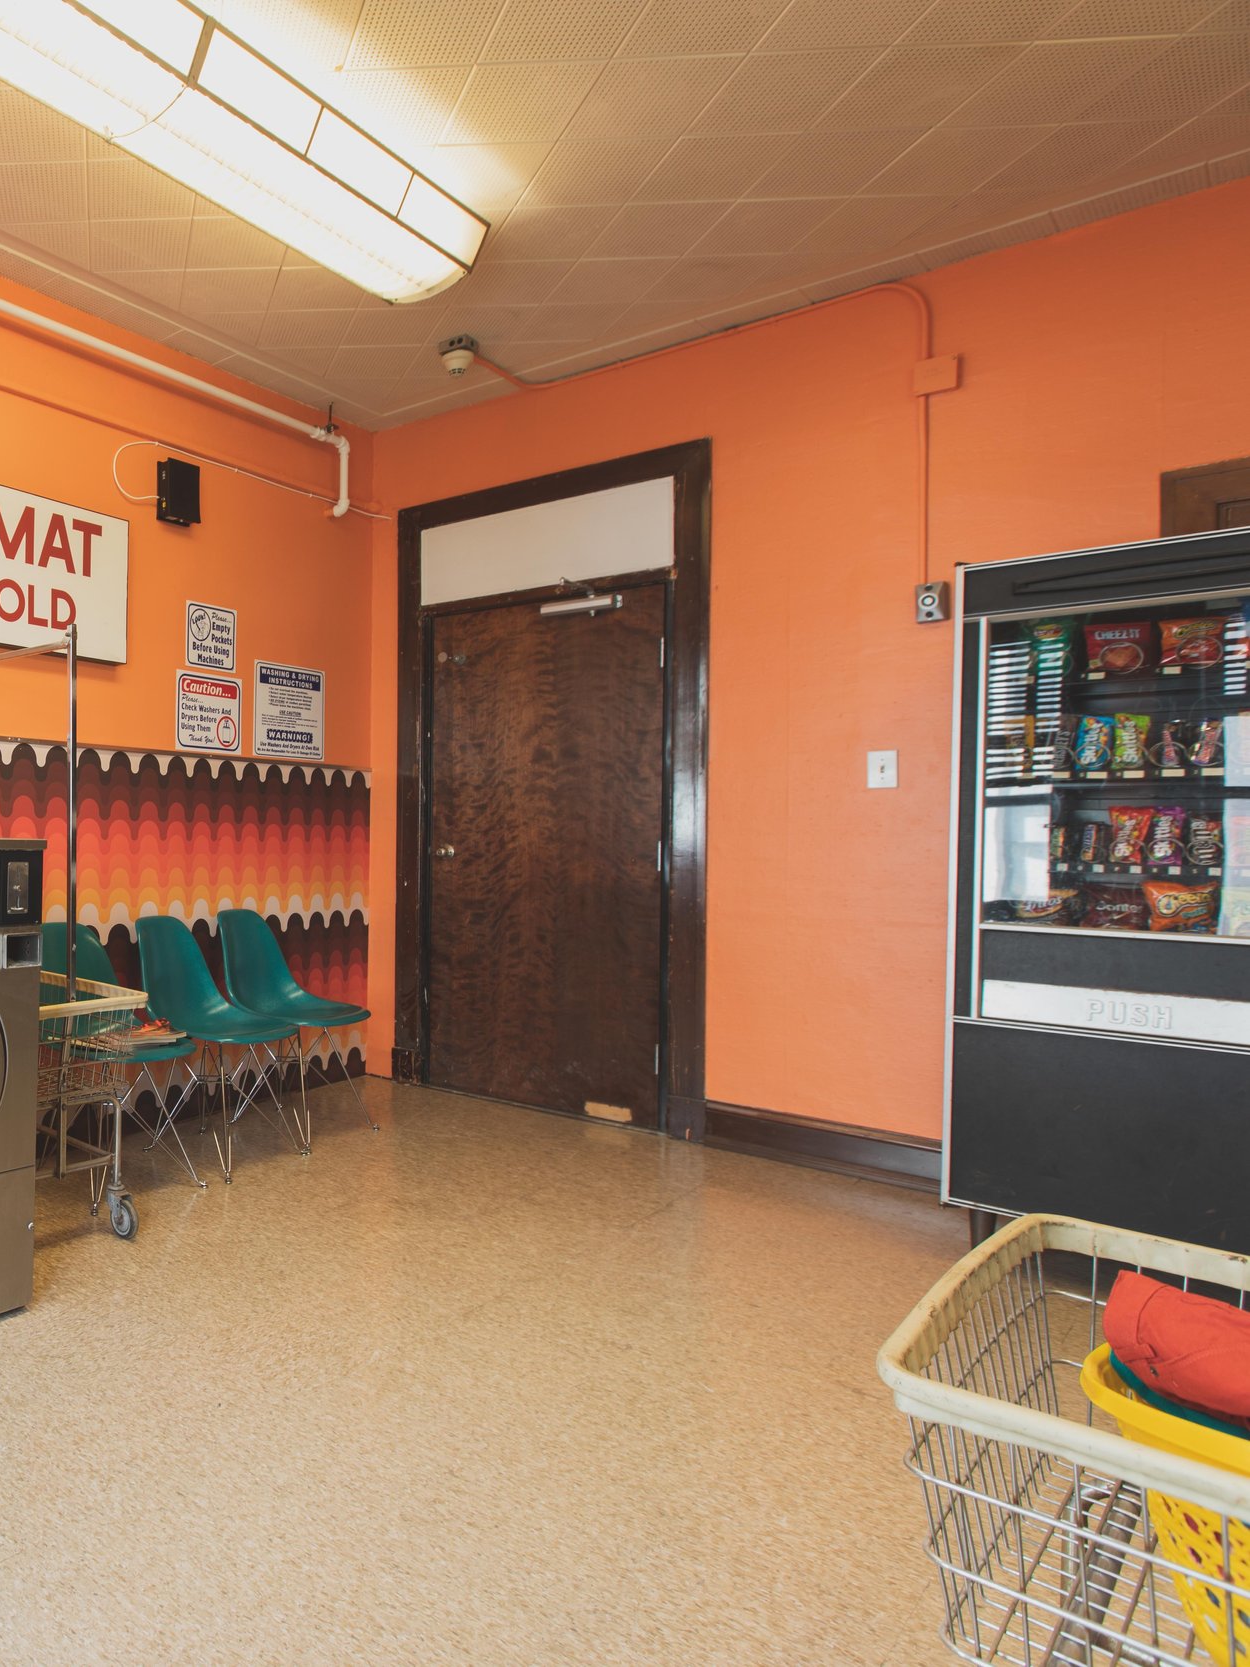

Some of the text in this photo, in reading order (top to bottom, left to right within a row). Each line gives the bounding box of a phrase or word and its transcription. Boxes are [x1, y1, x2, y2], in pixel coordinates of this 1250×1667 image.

[212, 621, 231, 635] Empty
[211, 633, 232, 646] Pockets
[192, 641, 229, 658] Before Using
[197, 653, 224, 666] Machines
[261, 667, 290, 678] WASHING
[298, 673, 320, 683] DRYING
[183, 679, 231, 697] Caution...
[268, 676, 313, 689] INSTRUCTIONS
[181, 702, 232, 716] Check Washers And
[181, 712, 217, 723] Dryers Before
[181, 722, 211, 732] Using Them
[268, 730, 311, 742] WARNING!
[1153, 815, 1173, 857] Skittles
[1086, 998, 1173, 1030] PUSH
